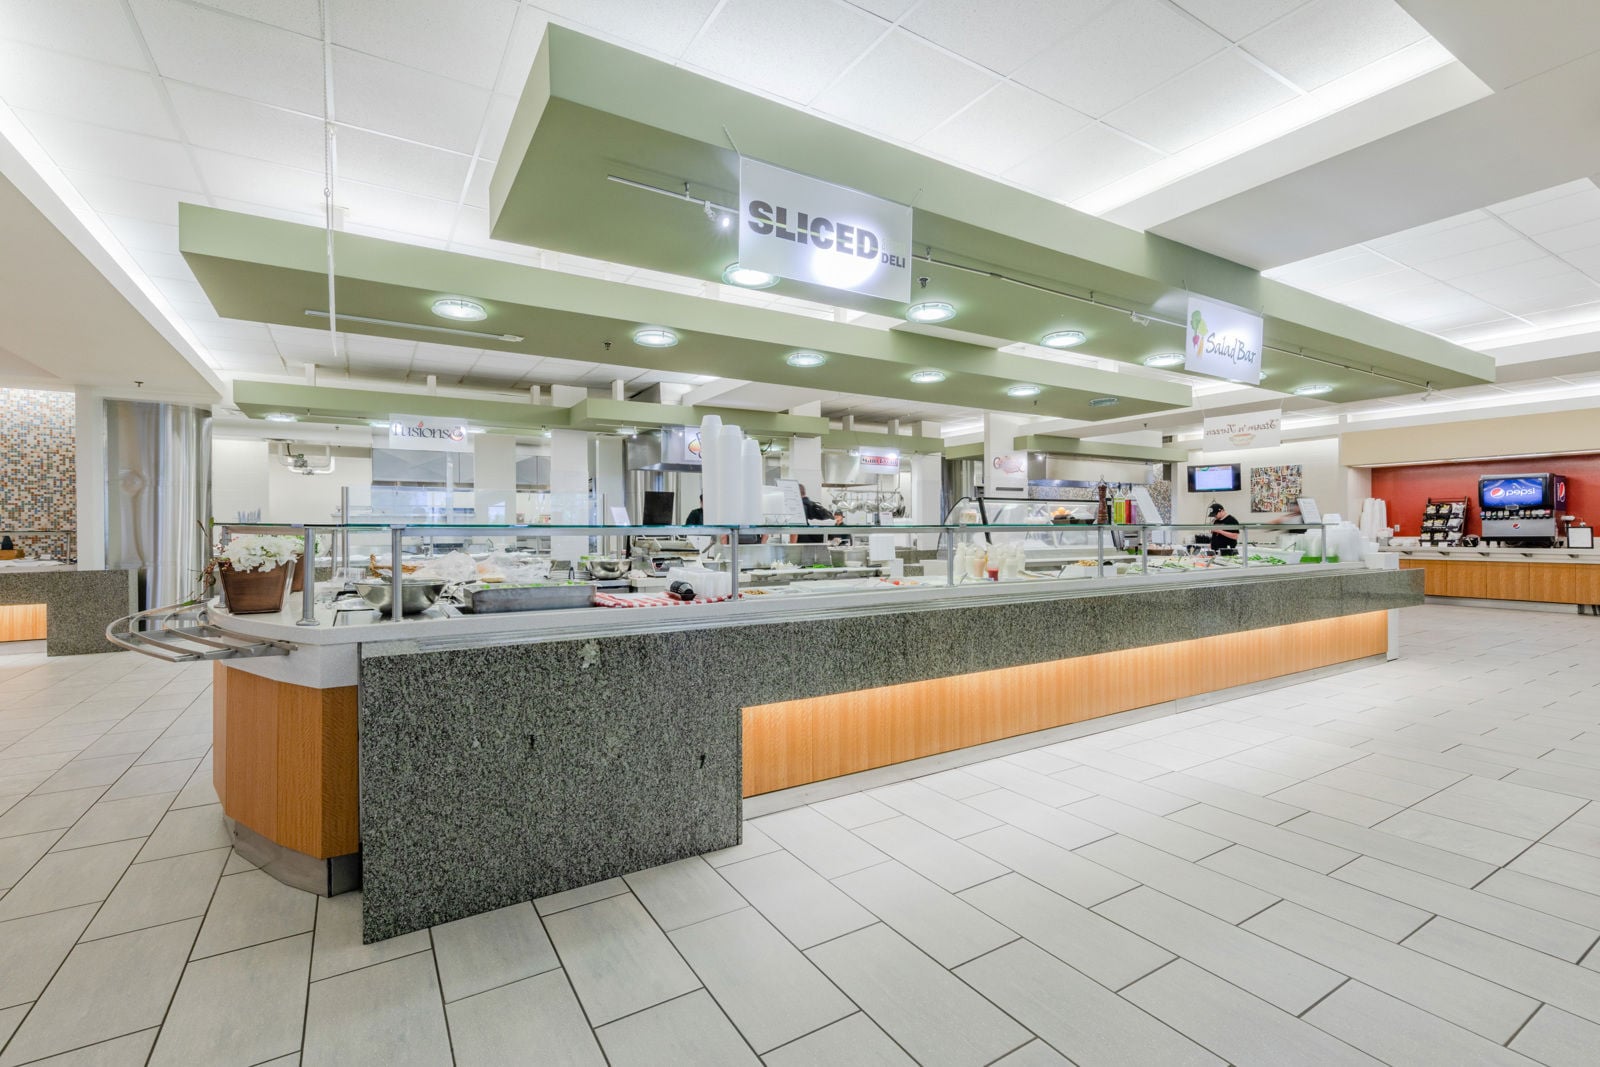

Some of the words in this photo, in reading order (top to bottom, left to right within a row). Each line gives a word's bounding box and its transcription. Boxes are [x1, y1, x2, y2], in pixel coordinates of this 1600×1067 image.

[748, 200, 879, 260] SLICED
[881, 252, 906, 269] DELI
[1206, 332, 1237, 364] Salad
[1237, 340, 1257, 363] Bar
[1505, 487, 1536, 497] pepsi
